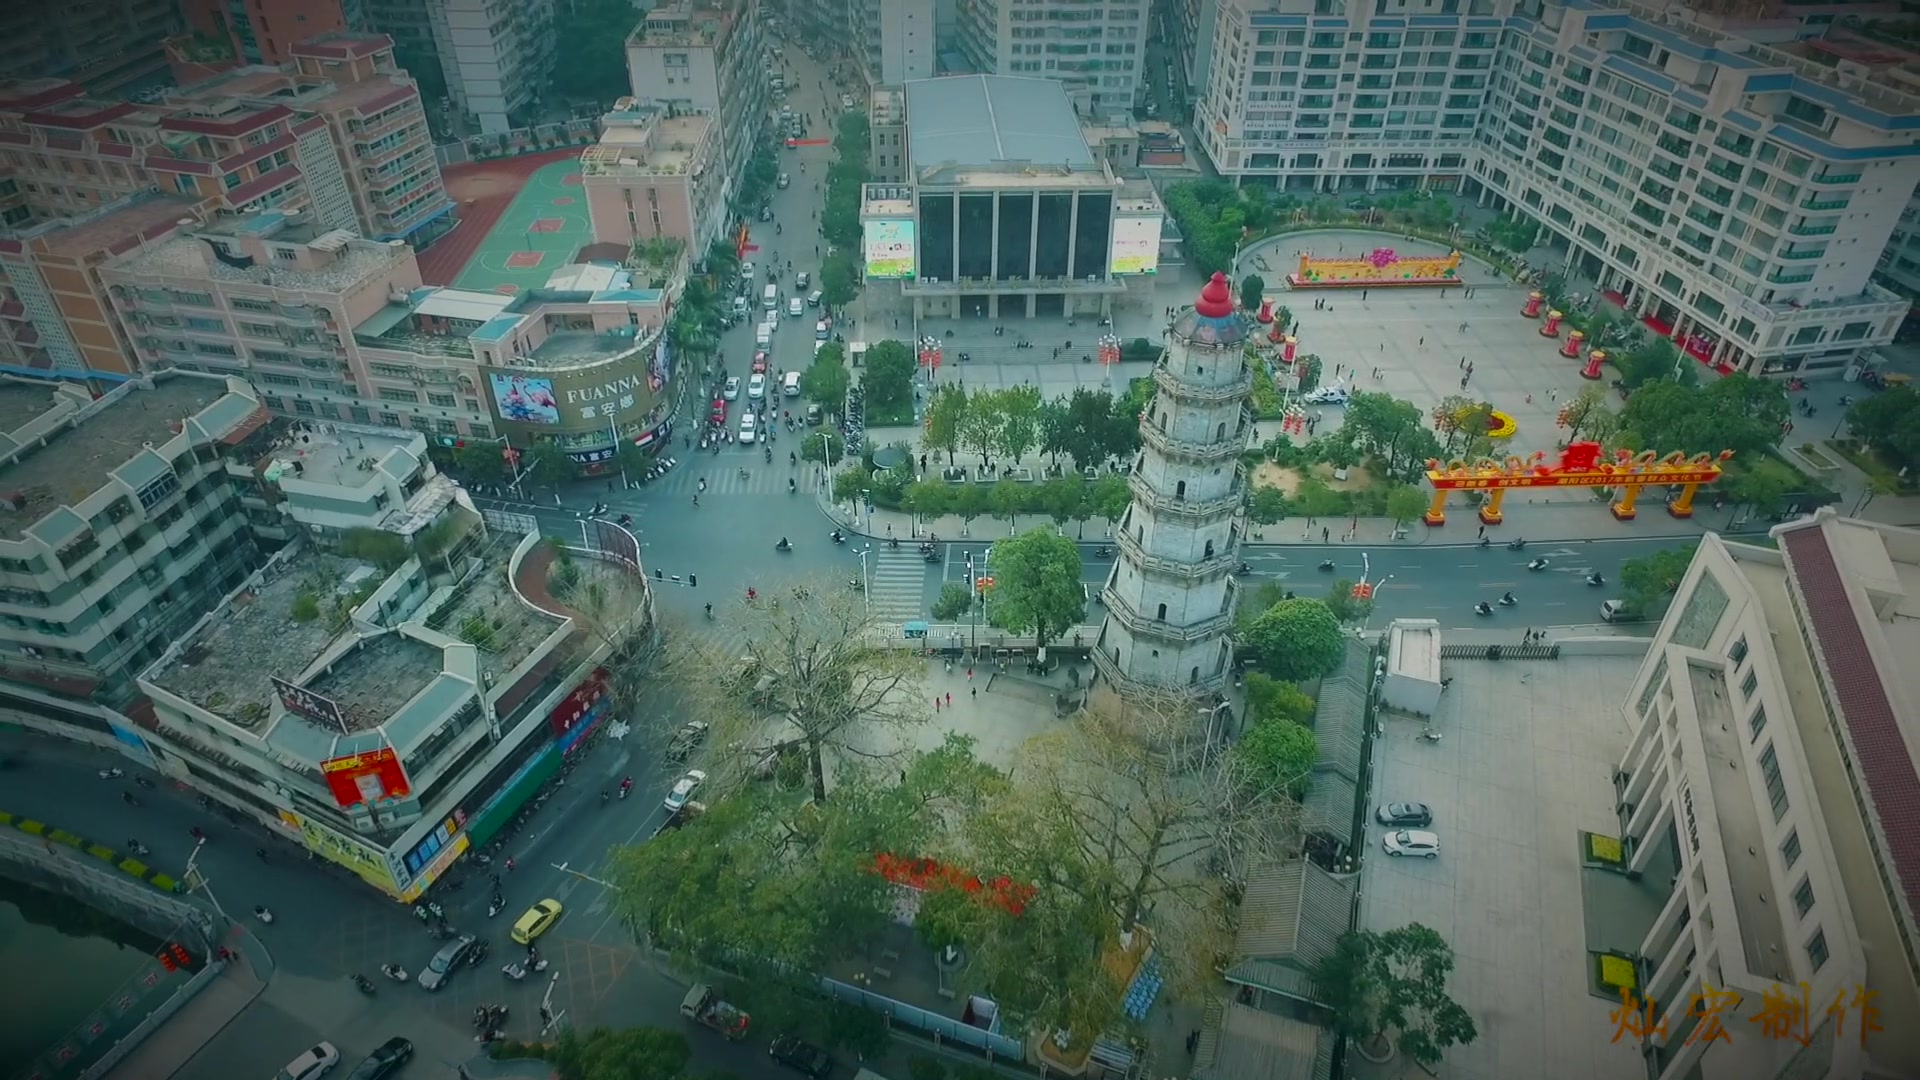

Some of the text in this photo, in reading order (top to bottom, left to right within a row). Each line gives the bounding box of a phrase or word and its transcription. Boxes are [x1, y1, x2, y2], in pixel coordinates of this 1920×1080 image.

[567, 374, 641, 403] FUANNA
[579, 395, 634, 419] 富安娜
